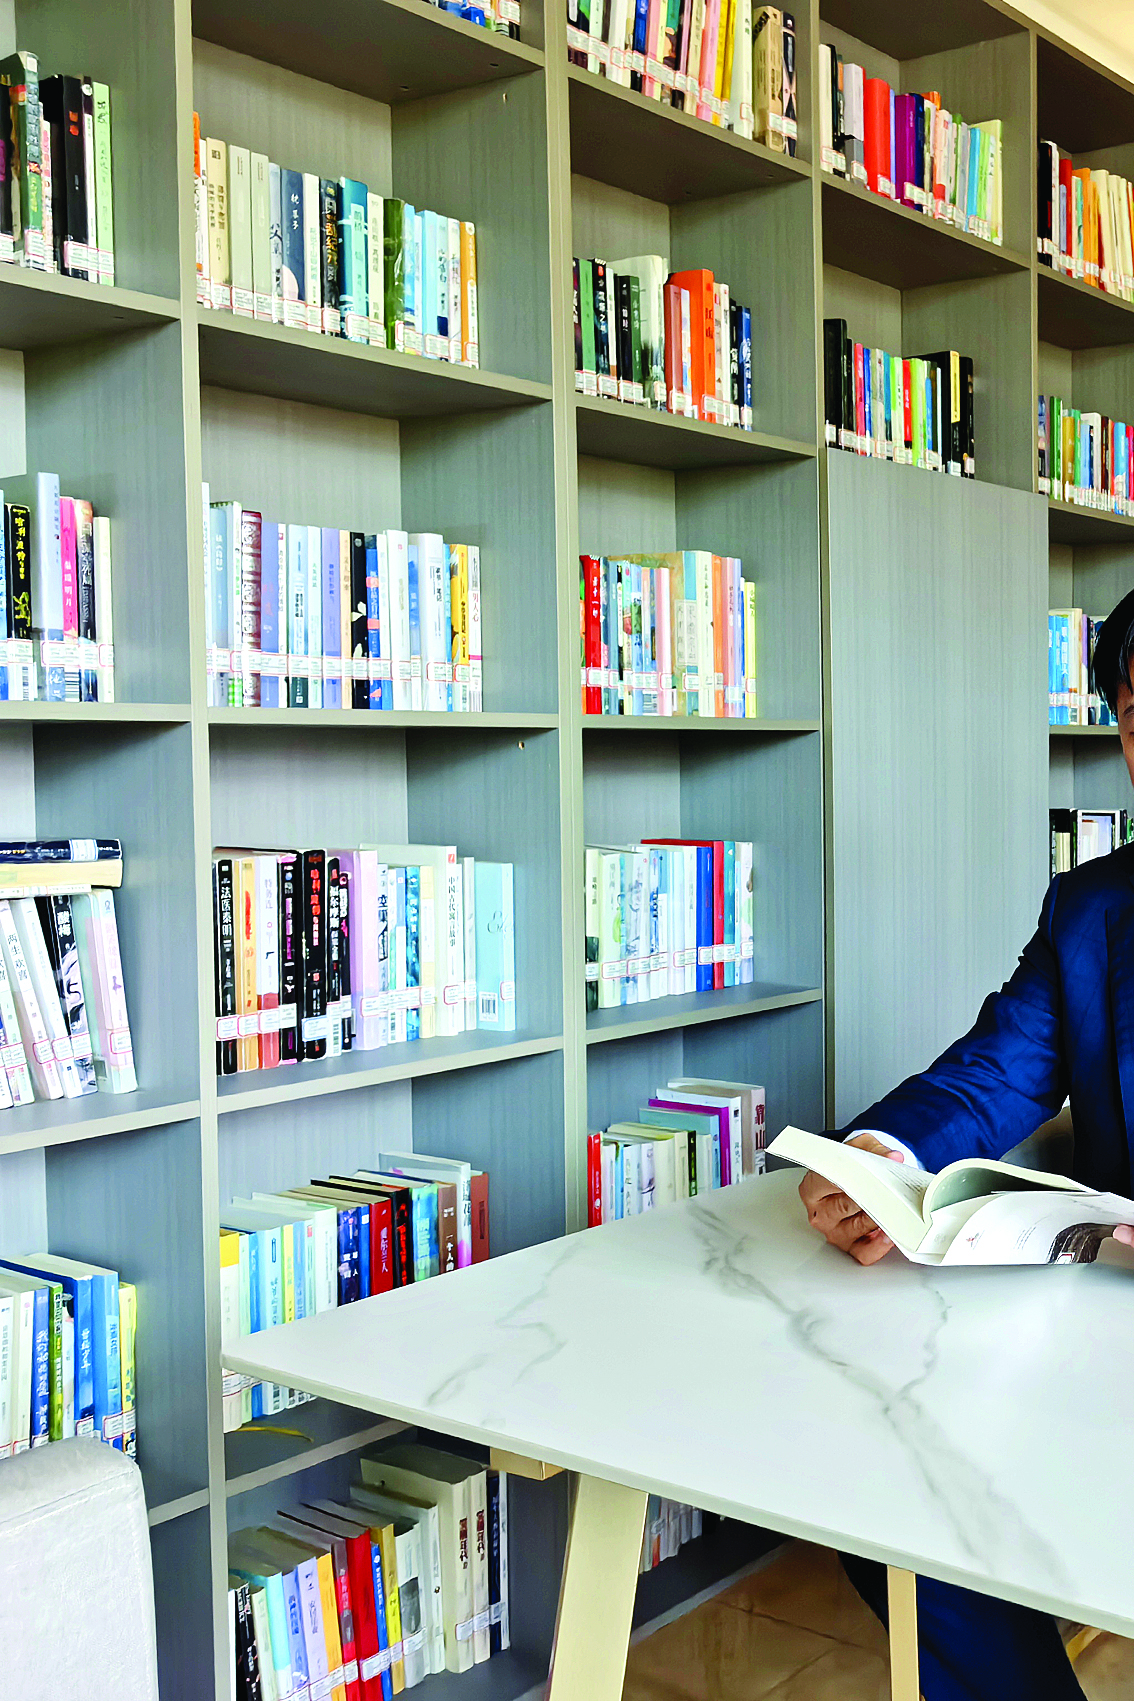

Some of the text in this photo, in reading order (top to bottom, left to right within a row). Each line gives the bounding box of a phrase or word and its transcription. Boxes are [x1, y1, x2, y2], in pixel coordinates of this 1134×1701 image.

[221, 886, 232, 936] 法医秦明
[448, 876, 456, 947] 中国古代寓言故事
[7, 932, 28, 981] 两生欢喜
